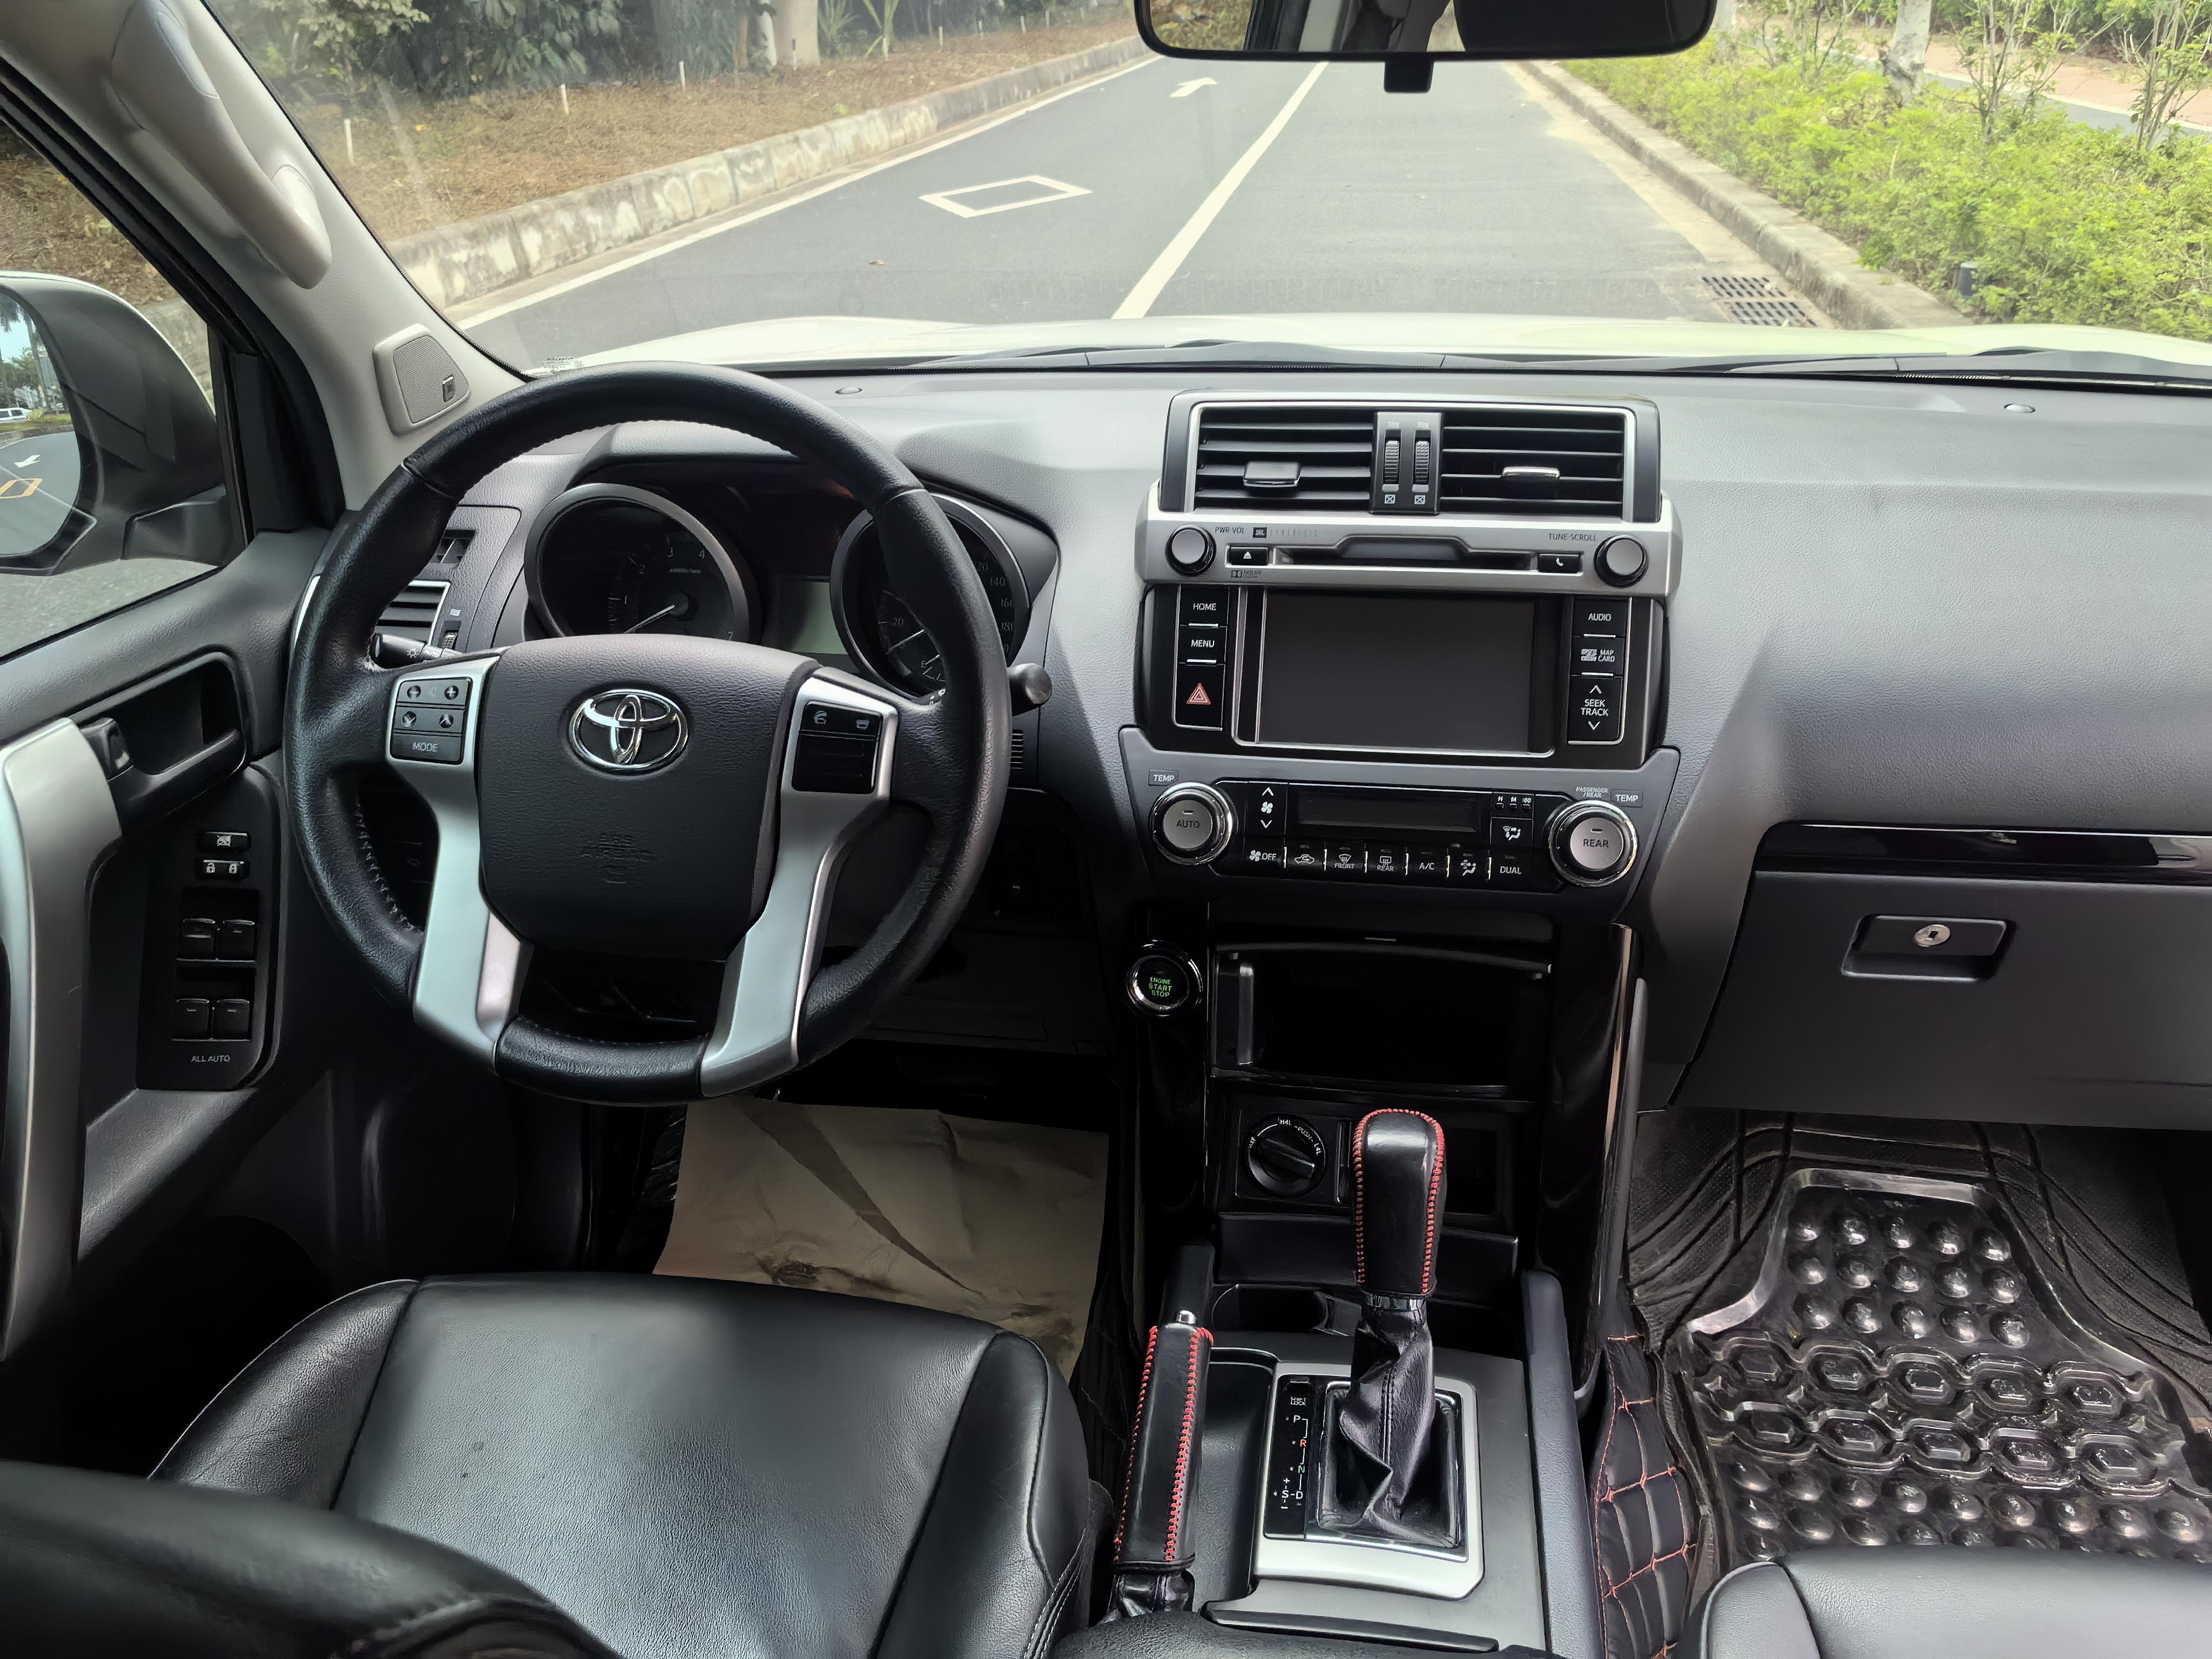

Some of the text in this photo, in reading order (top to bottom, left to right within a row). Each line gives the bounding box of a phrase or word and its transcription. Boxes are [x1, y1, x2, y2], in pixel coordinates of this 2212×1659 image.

[699, 549, 705, 559] 4
[990, 576, 1006, 587] 140
[1192, 603, 1217, 611] HOME
[1588, 613, 1611, 621] AUDIO
[1191, 639, 1215, 648] MENU
[1584, 699, 1606, 707] SEEK
[1581, 707, 1609, 717] TRACK
[412, 741, 439, 752] MODE
[1153, 774, 1175, 782] TEMP
[1615, 794, 1638, 802] TEMP
[1176, 819, 1201, 828] AUTO
[1583, 839, 1609, 848] REAR
[1262, 853, 1277, 861] OFF
[1419, 862, 1435, 871] A/C
[1500, 866, 1522, 874] DUAL
[1149, 983, 1172, 992] START
[207, 1054, 231, 1063] AUTO
[1293, 1414, 1301, 1423] P
[1300, 1439, 1307, 1447] R
[1298, 1465, 1305, 1474] N
[1282, 1490, 1304, 1500] S D
